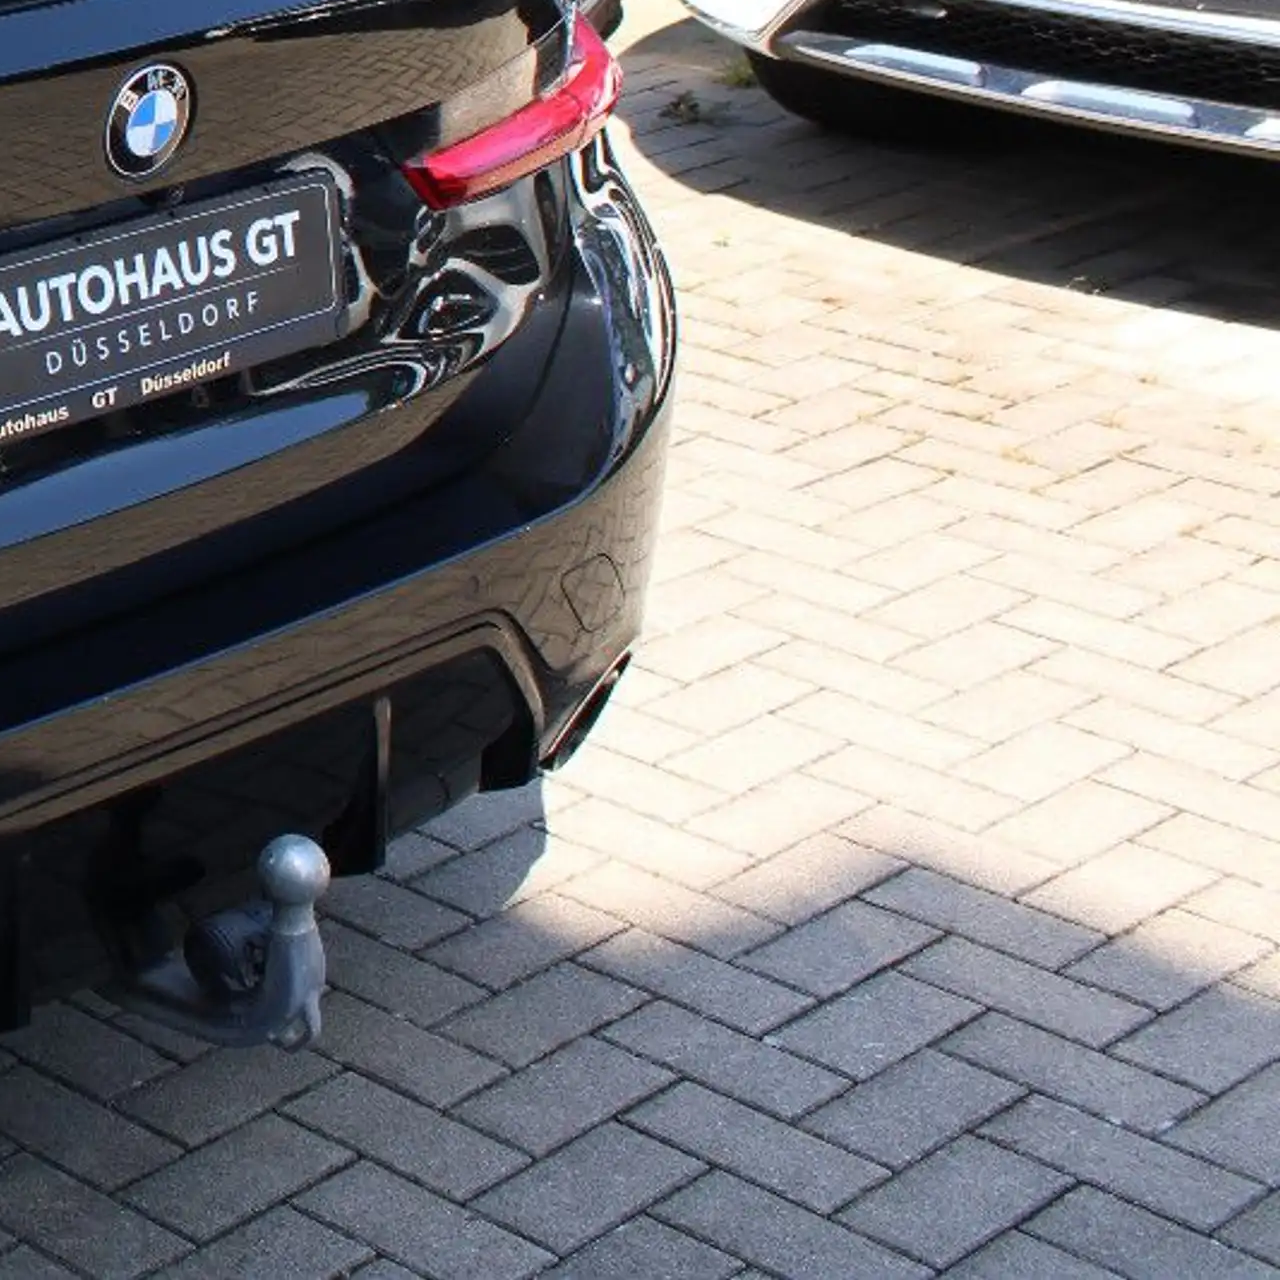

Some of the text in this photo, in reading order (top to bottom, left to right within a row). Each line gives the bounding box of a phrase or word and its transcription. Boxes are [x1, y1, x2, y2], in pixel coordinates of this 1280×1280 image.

[246, 210, 301, 266] GT
[45, 291, 258, 375] DÜSSELDORF
[91, 386, 118, 409] GT
[141, 351, 231, 396] Düsseldorf
